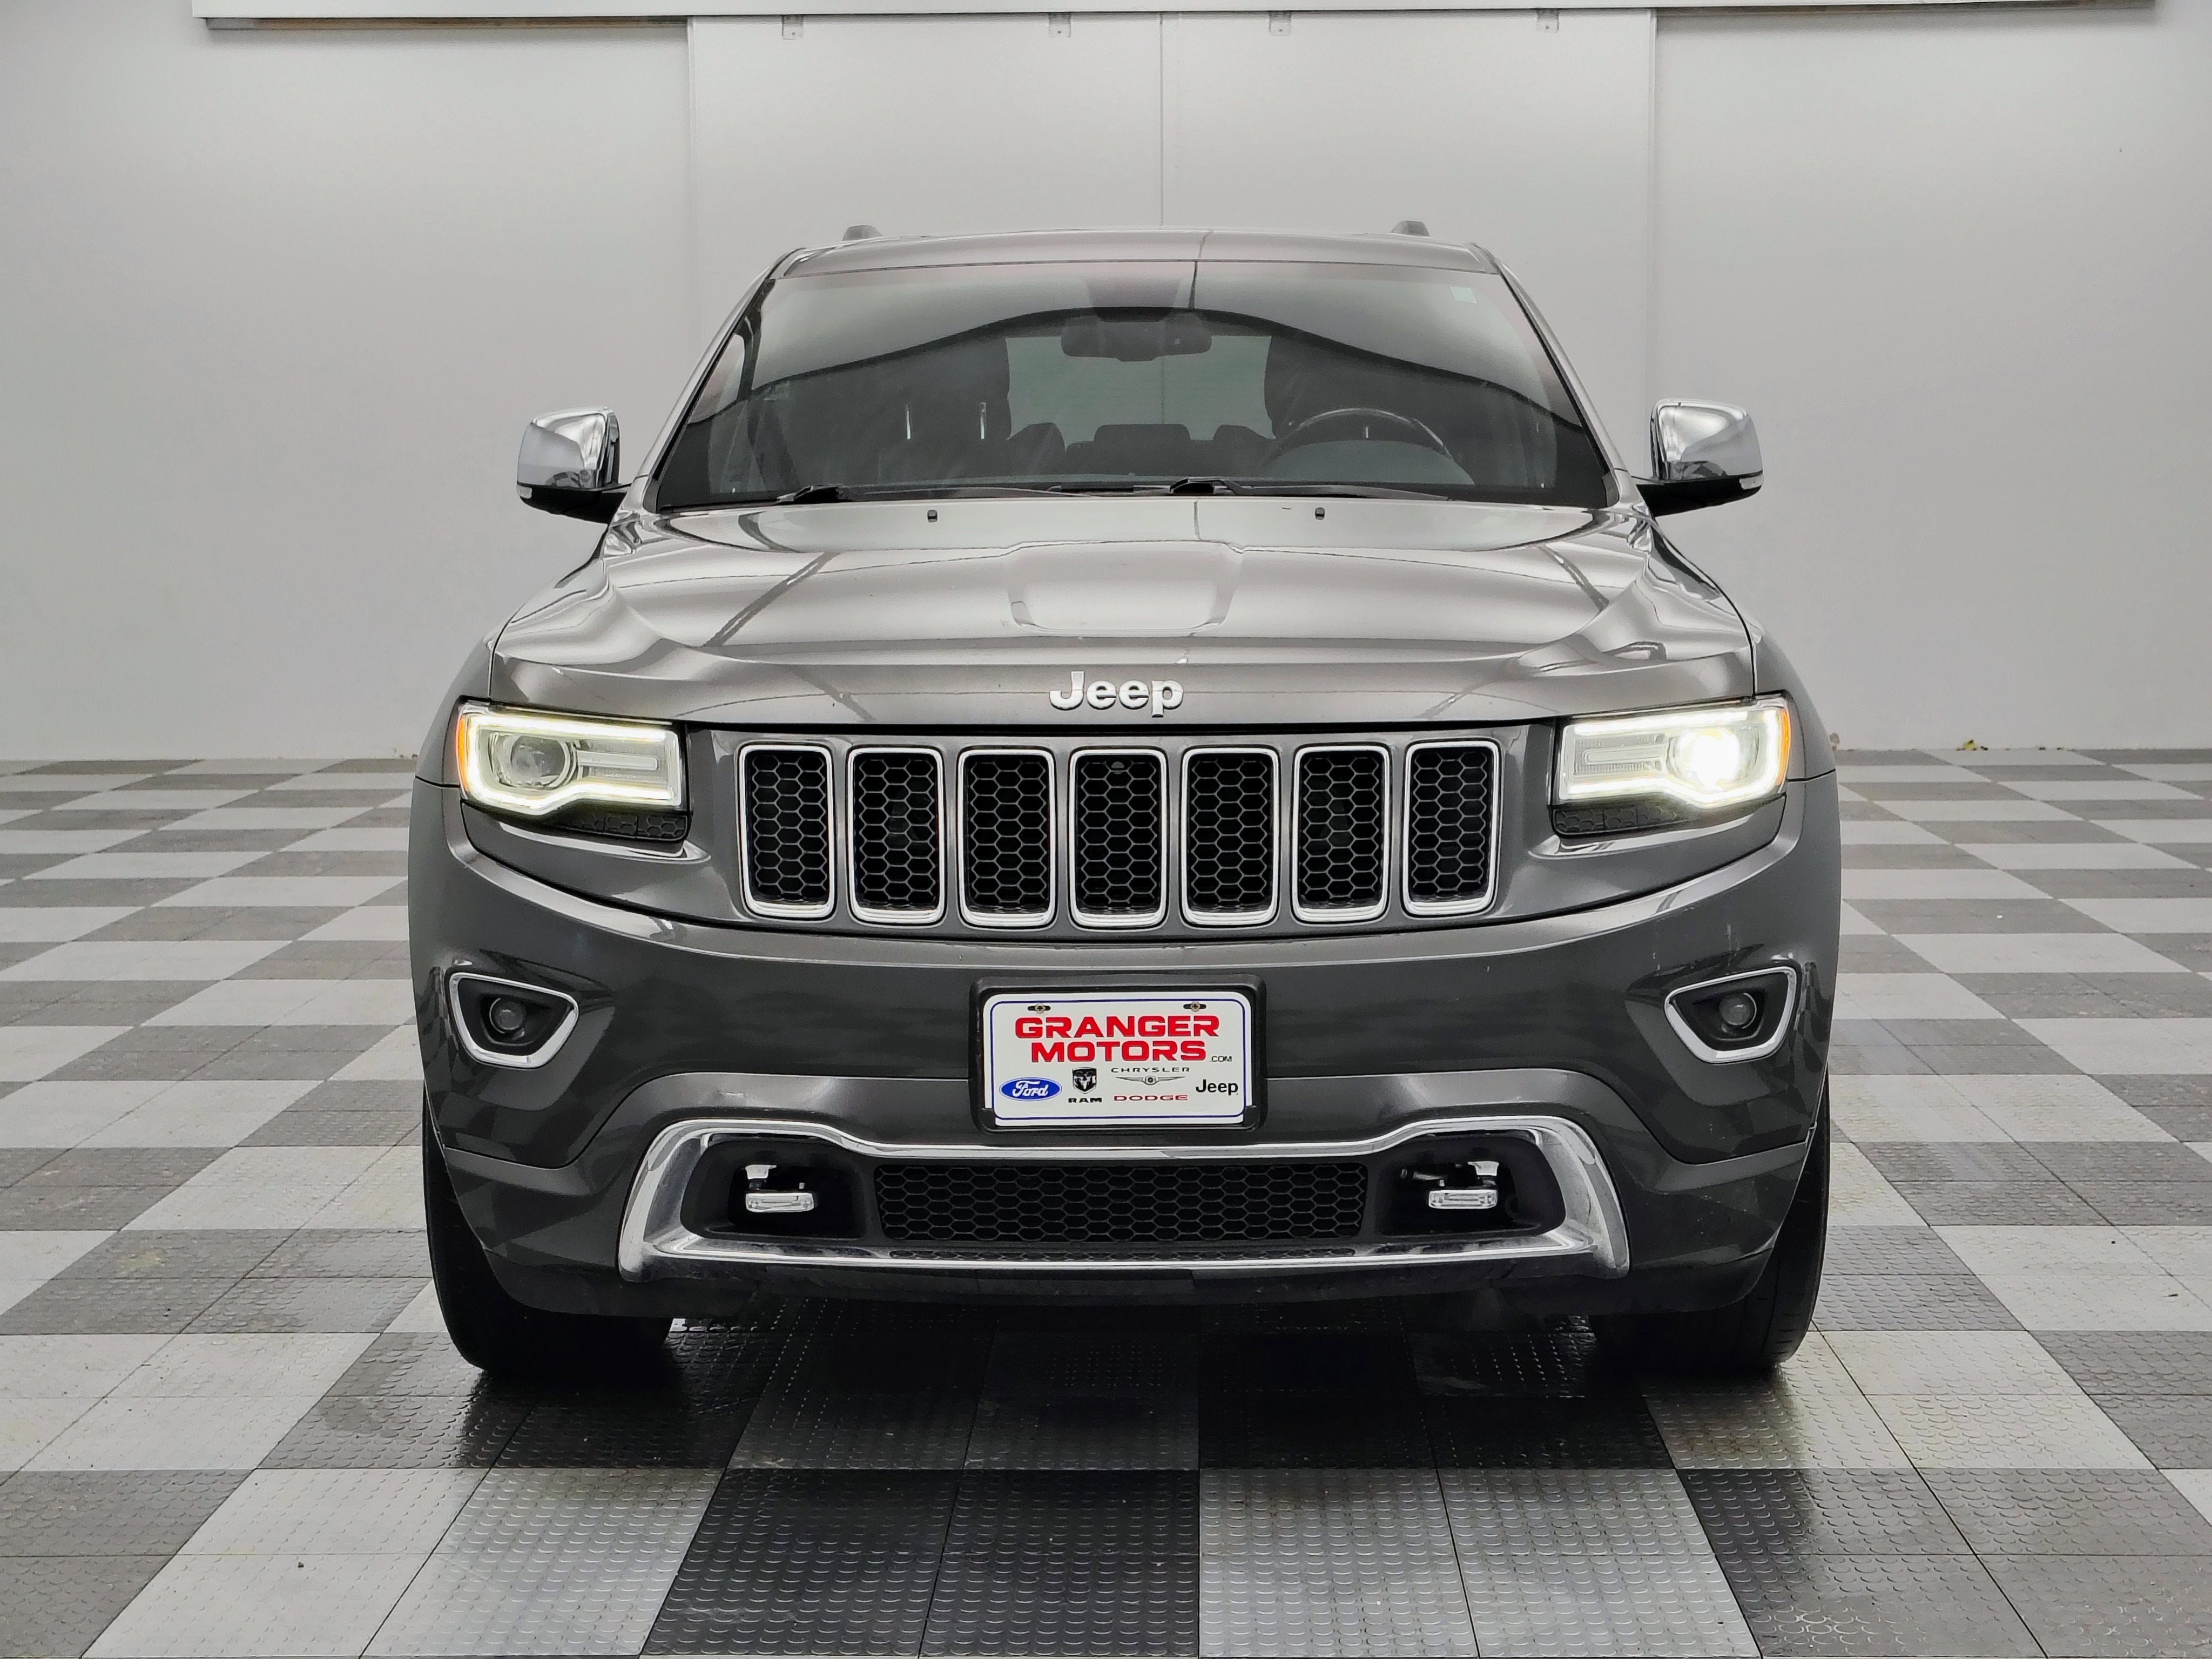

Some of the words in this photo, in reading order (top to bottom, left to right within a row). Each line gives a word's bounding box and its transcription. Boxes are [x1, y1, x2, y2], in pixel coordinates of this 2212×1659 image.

[1049, 670, 1184, 718] Jeep
[1015, 1015, 1219, 1038] GRANGER
[1031, 1041, 1206, 1062] MOTORS
[1011, 1081, 1049, 1097] Ford
[1195, 1080, 1238, 1095] Jeep
